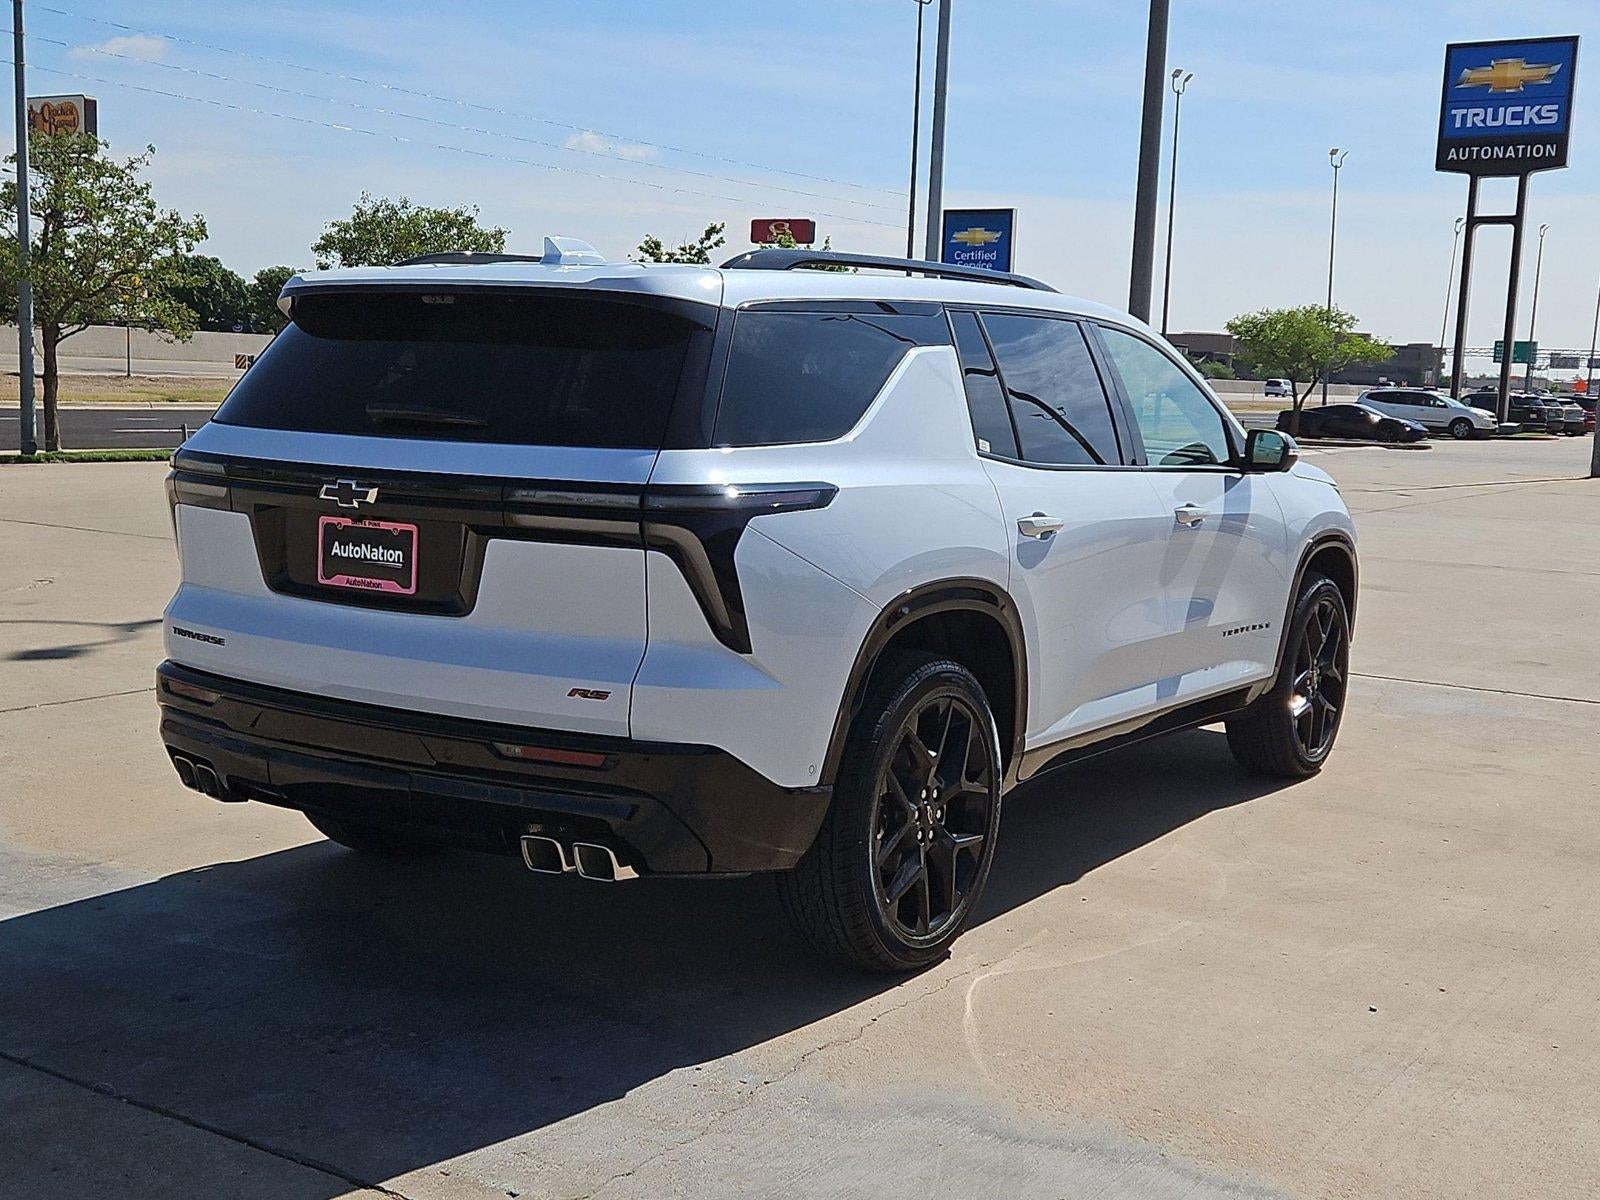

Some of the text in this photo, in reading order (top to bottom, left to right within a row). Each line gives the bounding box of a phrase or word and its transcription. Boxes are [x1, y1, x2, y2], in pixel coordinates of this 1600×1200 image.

[1451, 104, 1559, 128] TRUCKS
[1447, 143, 1557, 161] AUTONATION
[954, 250, 997, 261] Certified
[331, 541, 404, 563] AutoNation
[345, 577, 383, 589] AutoNation
[172, 626, 226, 646] TRAVERSE
[1222, 622, 1271, 637] TRAVERSE
[566, 687, 612, 701] RS
